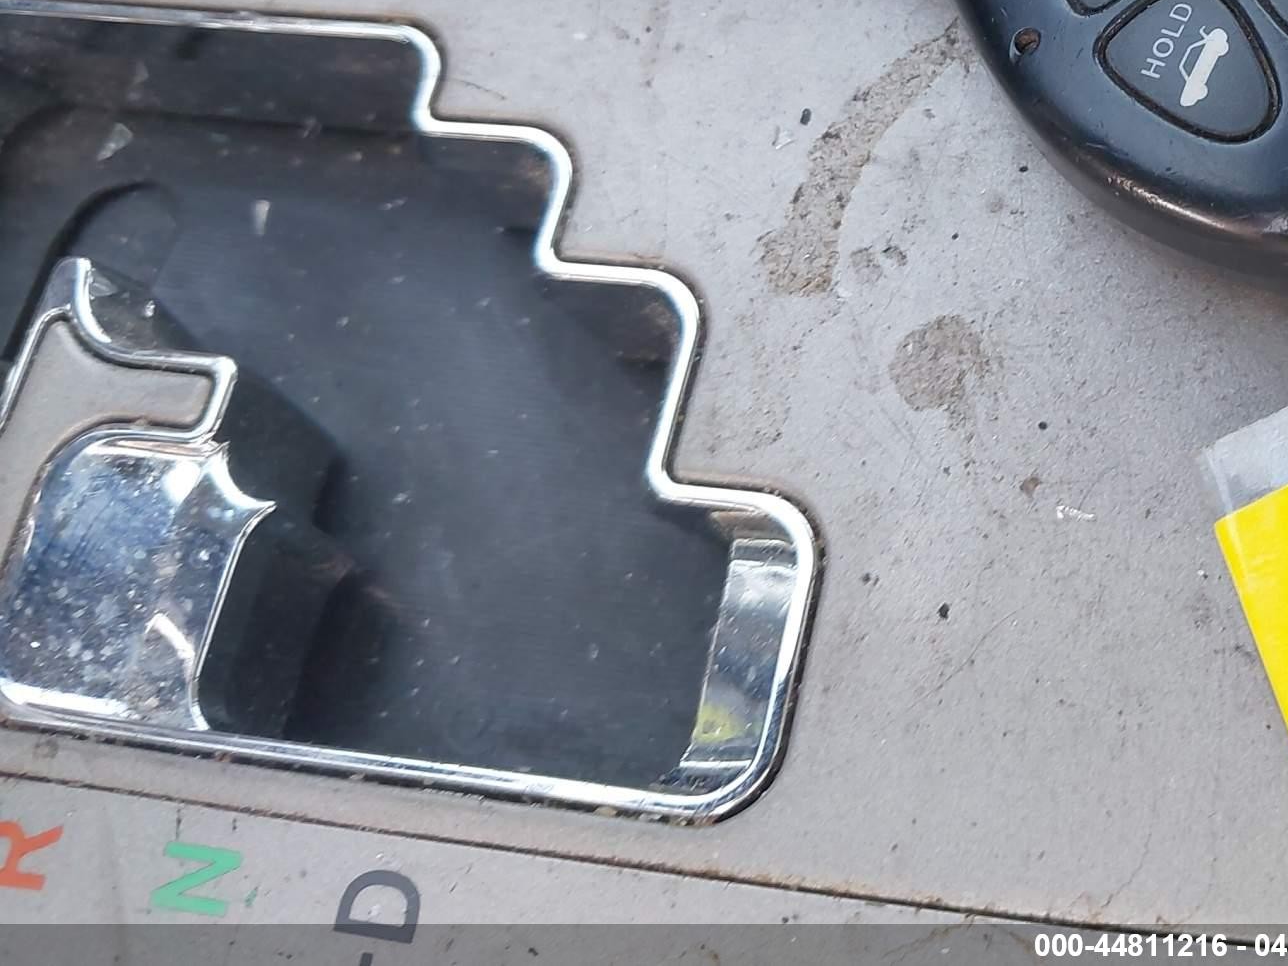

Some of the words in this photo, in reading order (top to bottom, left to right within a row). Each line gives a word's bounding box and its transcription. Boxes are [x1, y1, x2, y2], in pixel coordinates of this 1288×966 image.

[1139, 2, 1193, 80] HOLD
[0, 820, 65, 891] R
[150, 840, 244, 917] N
